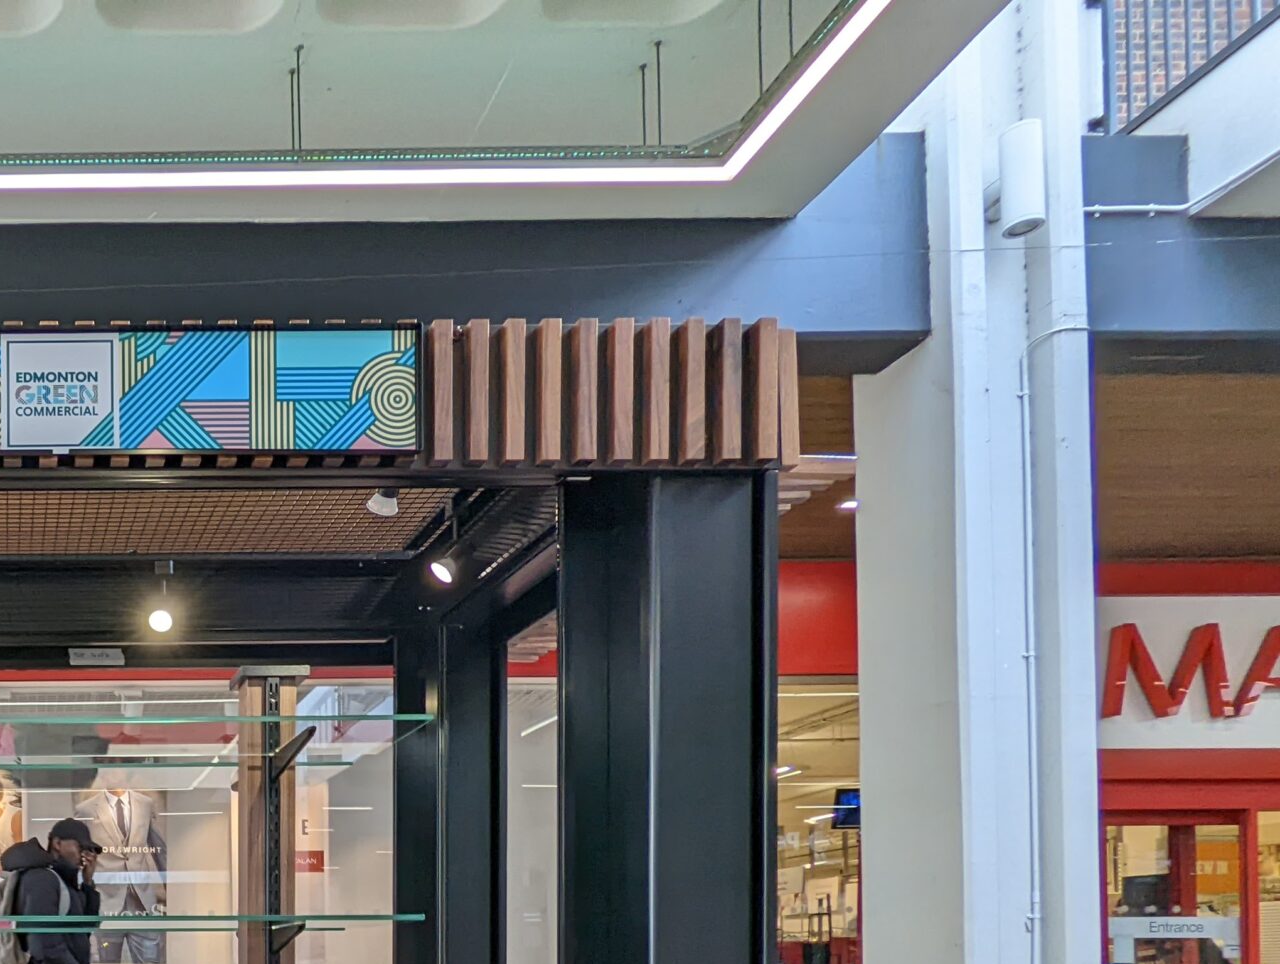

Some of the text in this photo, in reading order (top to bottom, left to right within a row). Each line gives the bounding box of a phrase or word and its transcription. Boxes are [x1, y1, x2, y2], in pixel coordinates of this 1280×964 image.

[15, 371, 99, 384] EDMONTON
[15, 384, 99, 405] GREEN
[15, 406, 99, 417] COMMERCIAL
[295, 857, 318, 865] ALAN
[1149, 920, 1205, 934] Entrance
